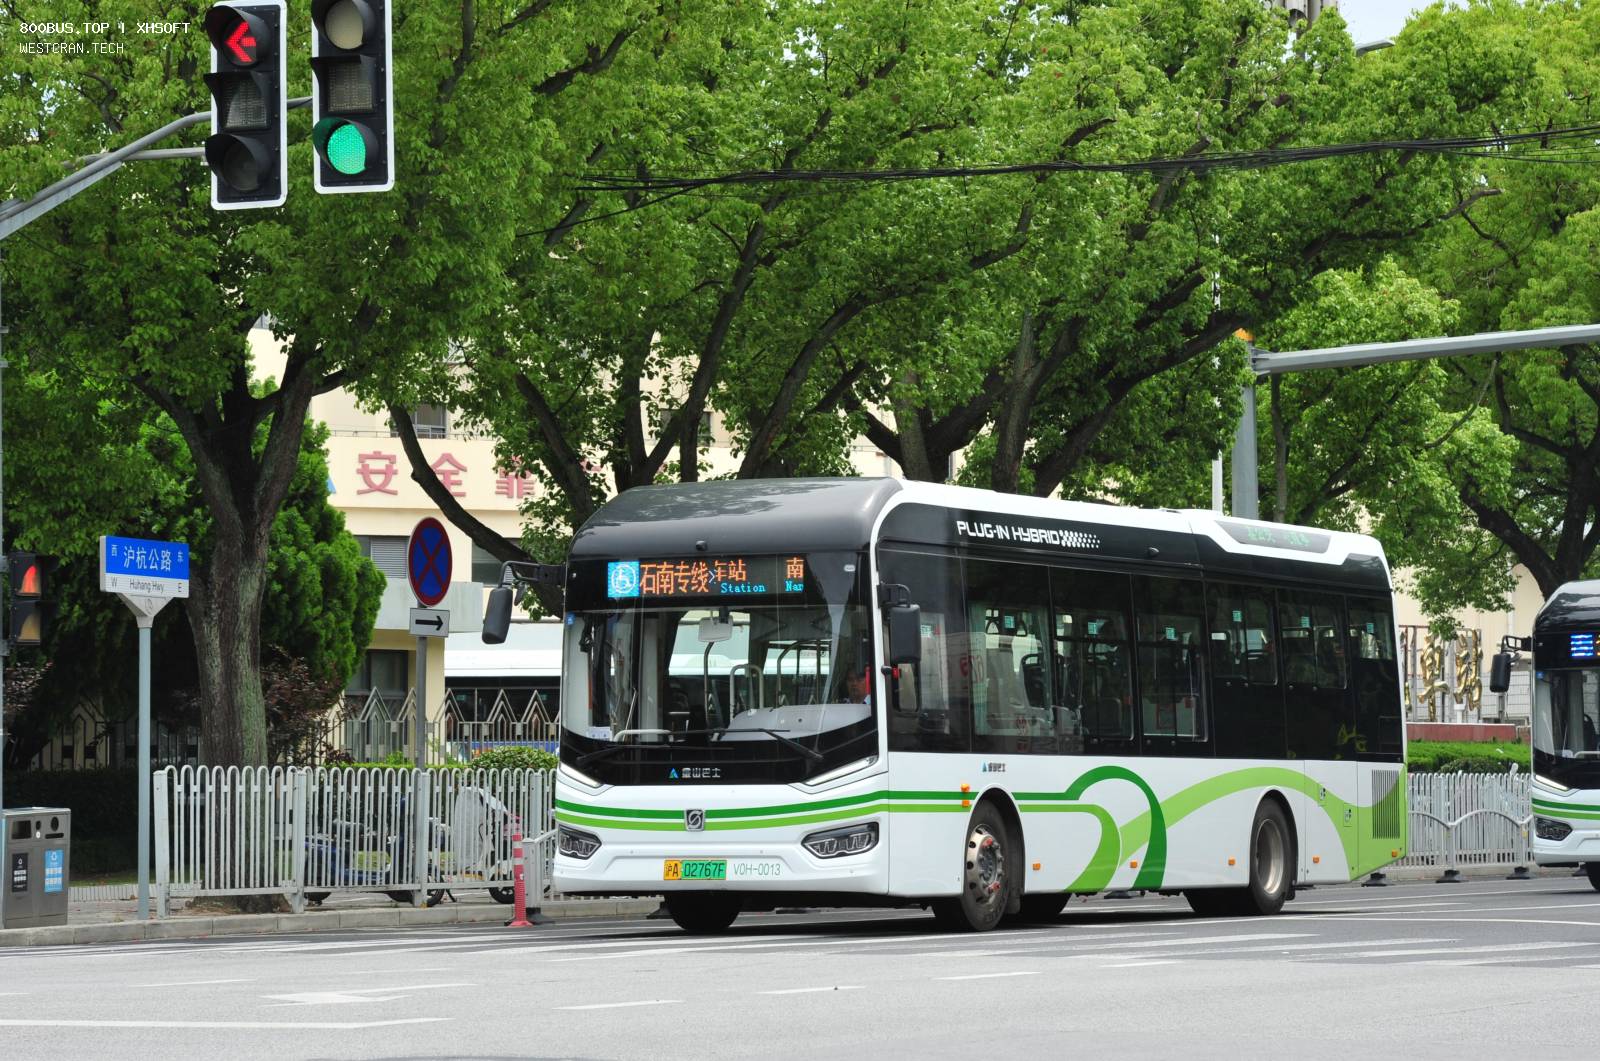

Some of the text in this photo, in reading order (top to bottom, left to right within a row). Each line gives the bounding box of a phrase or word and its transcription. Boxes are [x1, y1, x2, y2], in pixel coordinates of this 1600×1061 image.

[956, 521, 1060, 545] PLUG-IN HYBRID
[111, 544, 184, 572] 西 沪杭公路 东
[786, 557, 804, 579] 南
[129, 578, 151, 593] Huhang
[152, 581, 164, 593] Hwy
[178, 582, 183, 593] E
[640, 561, 709, 595] 石南专线
[720, 582, 767, 594] Station
